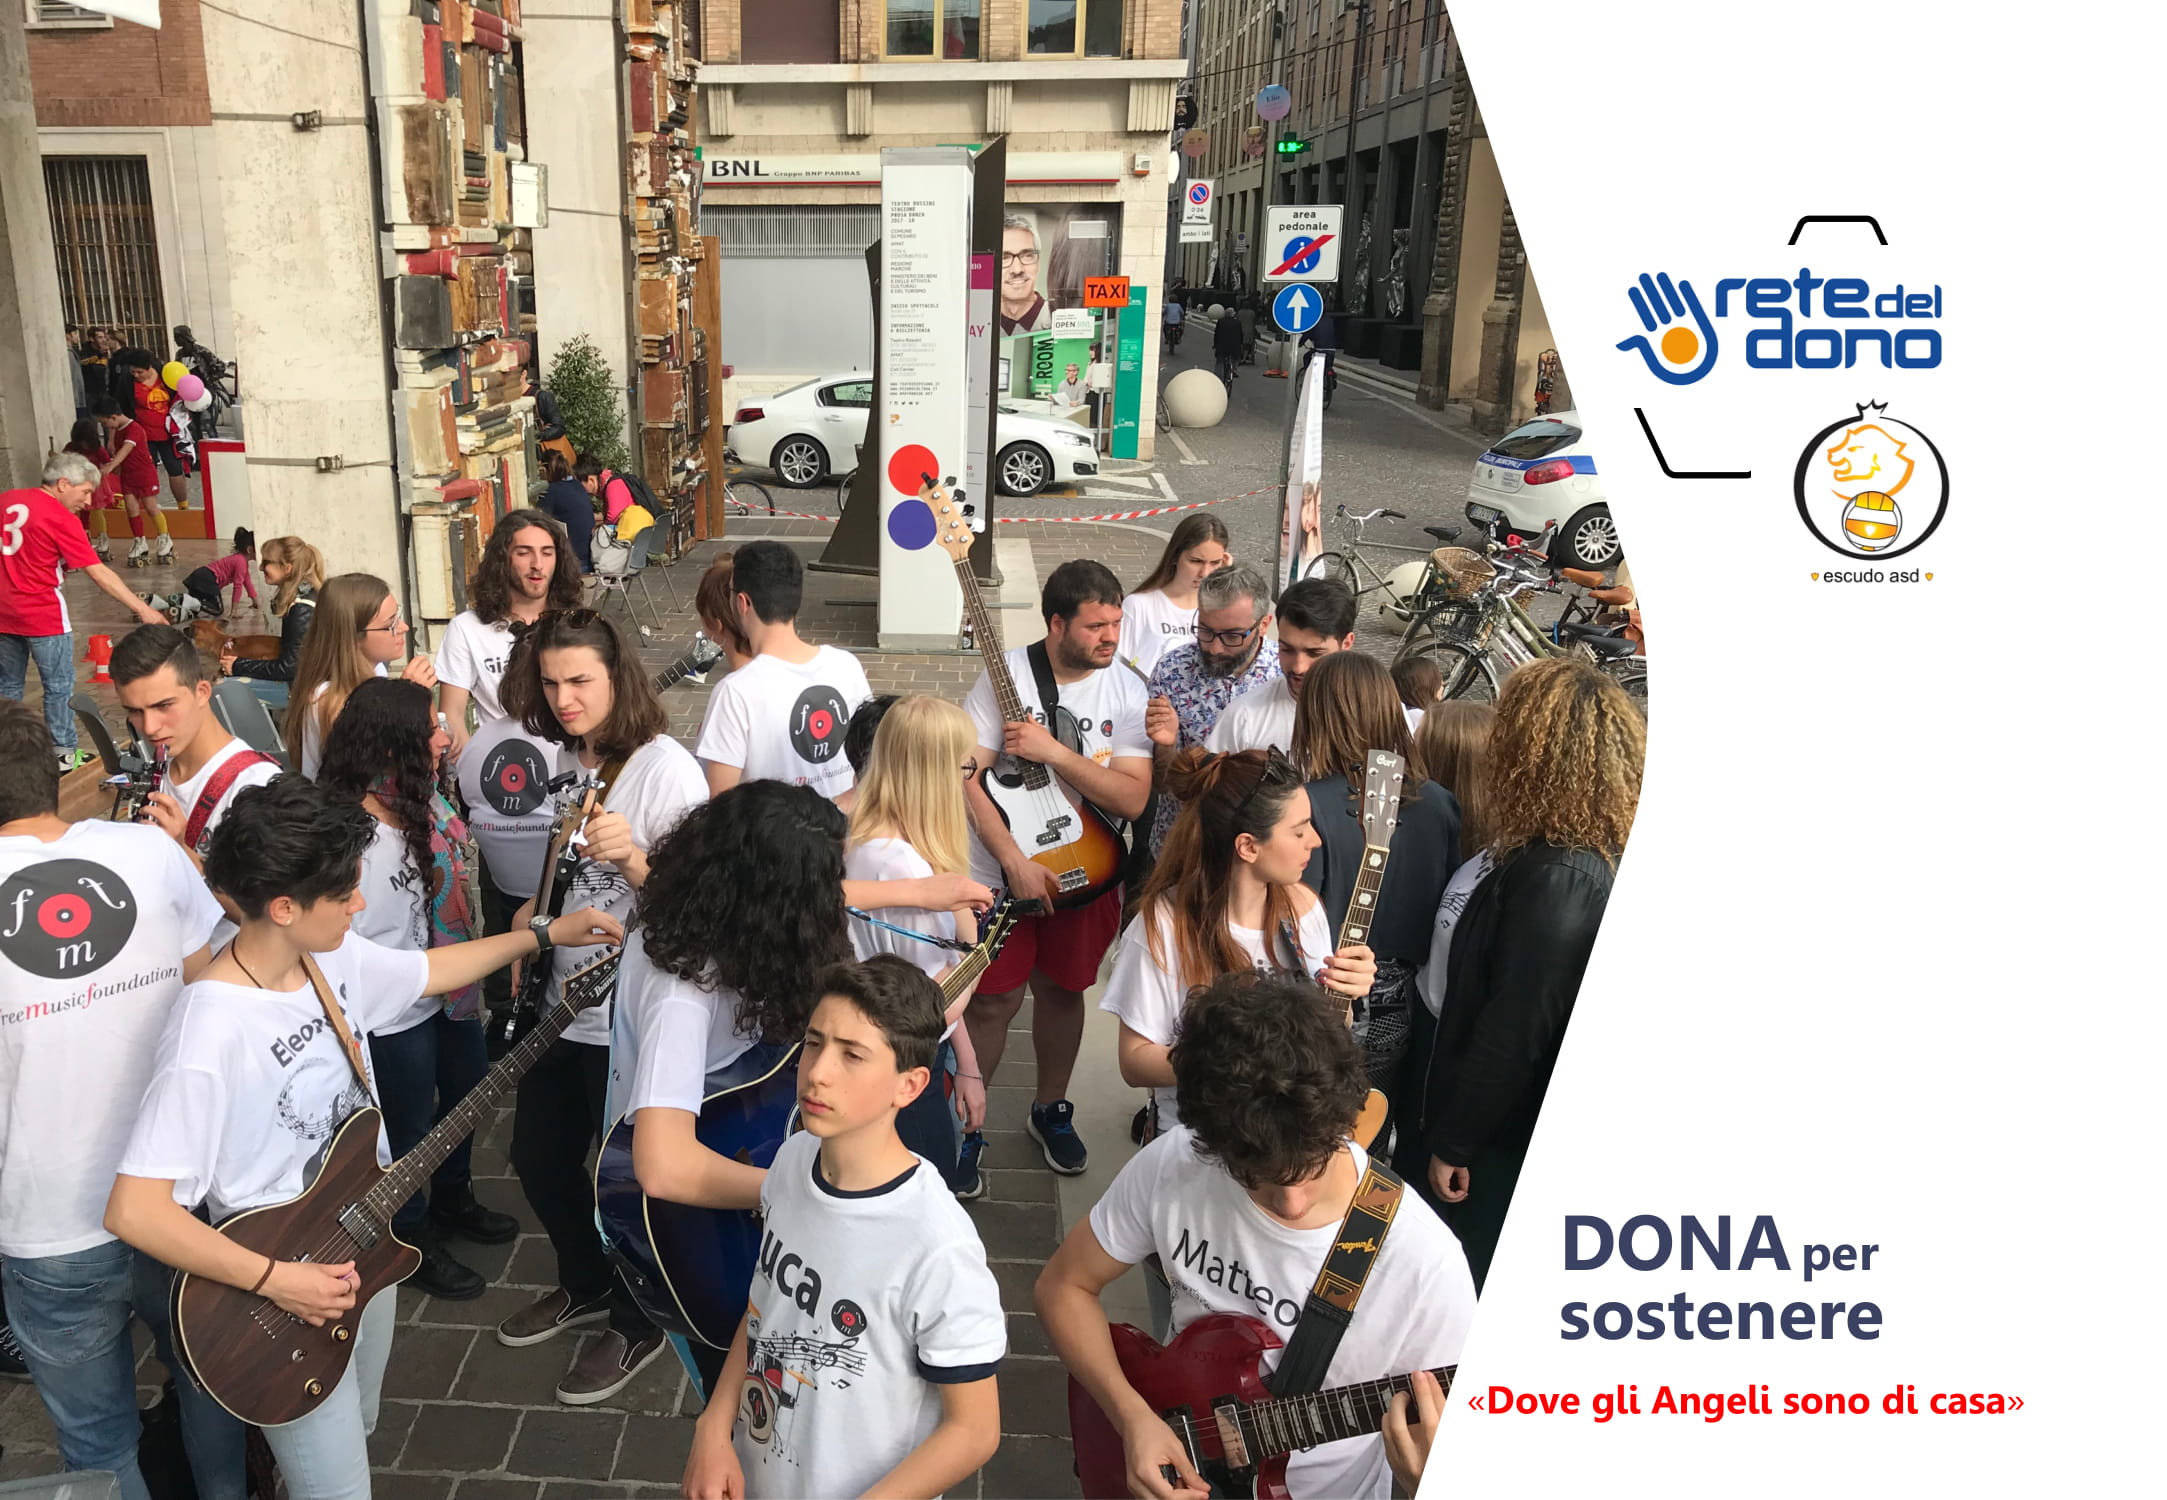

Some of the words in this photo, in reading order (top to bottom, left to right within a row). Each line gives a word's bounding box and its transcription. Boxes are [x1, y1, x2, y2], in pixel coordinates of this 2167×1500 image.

[711, 160, 769, 176] BNL
[1279, 222, 1328, 232] pedonale
[1088, 284, 1126, 299] TAXI
[969, 325, 985, 337] AY
[1055, 321, 1076, 329] OPEN
[1160, 622, 1190, 636] Dani
[484, 657, 509, 674] Gia
[1376, 754, 1397, 768] Cort
[0, 966, 179, 1027] reemusicfoundation
[761, 1215, 822, 1319] uca
[1172, 1229, 1301, 1326] Matteo
